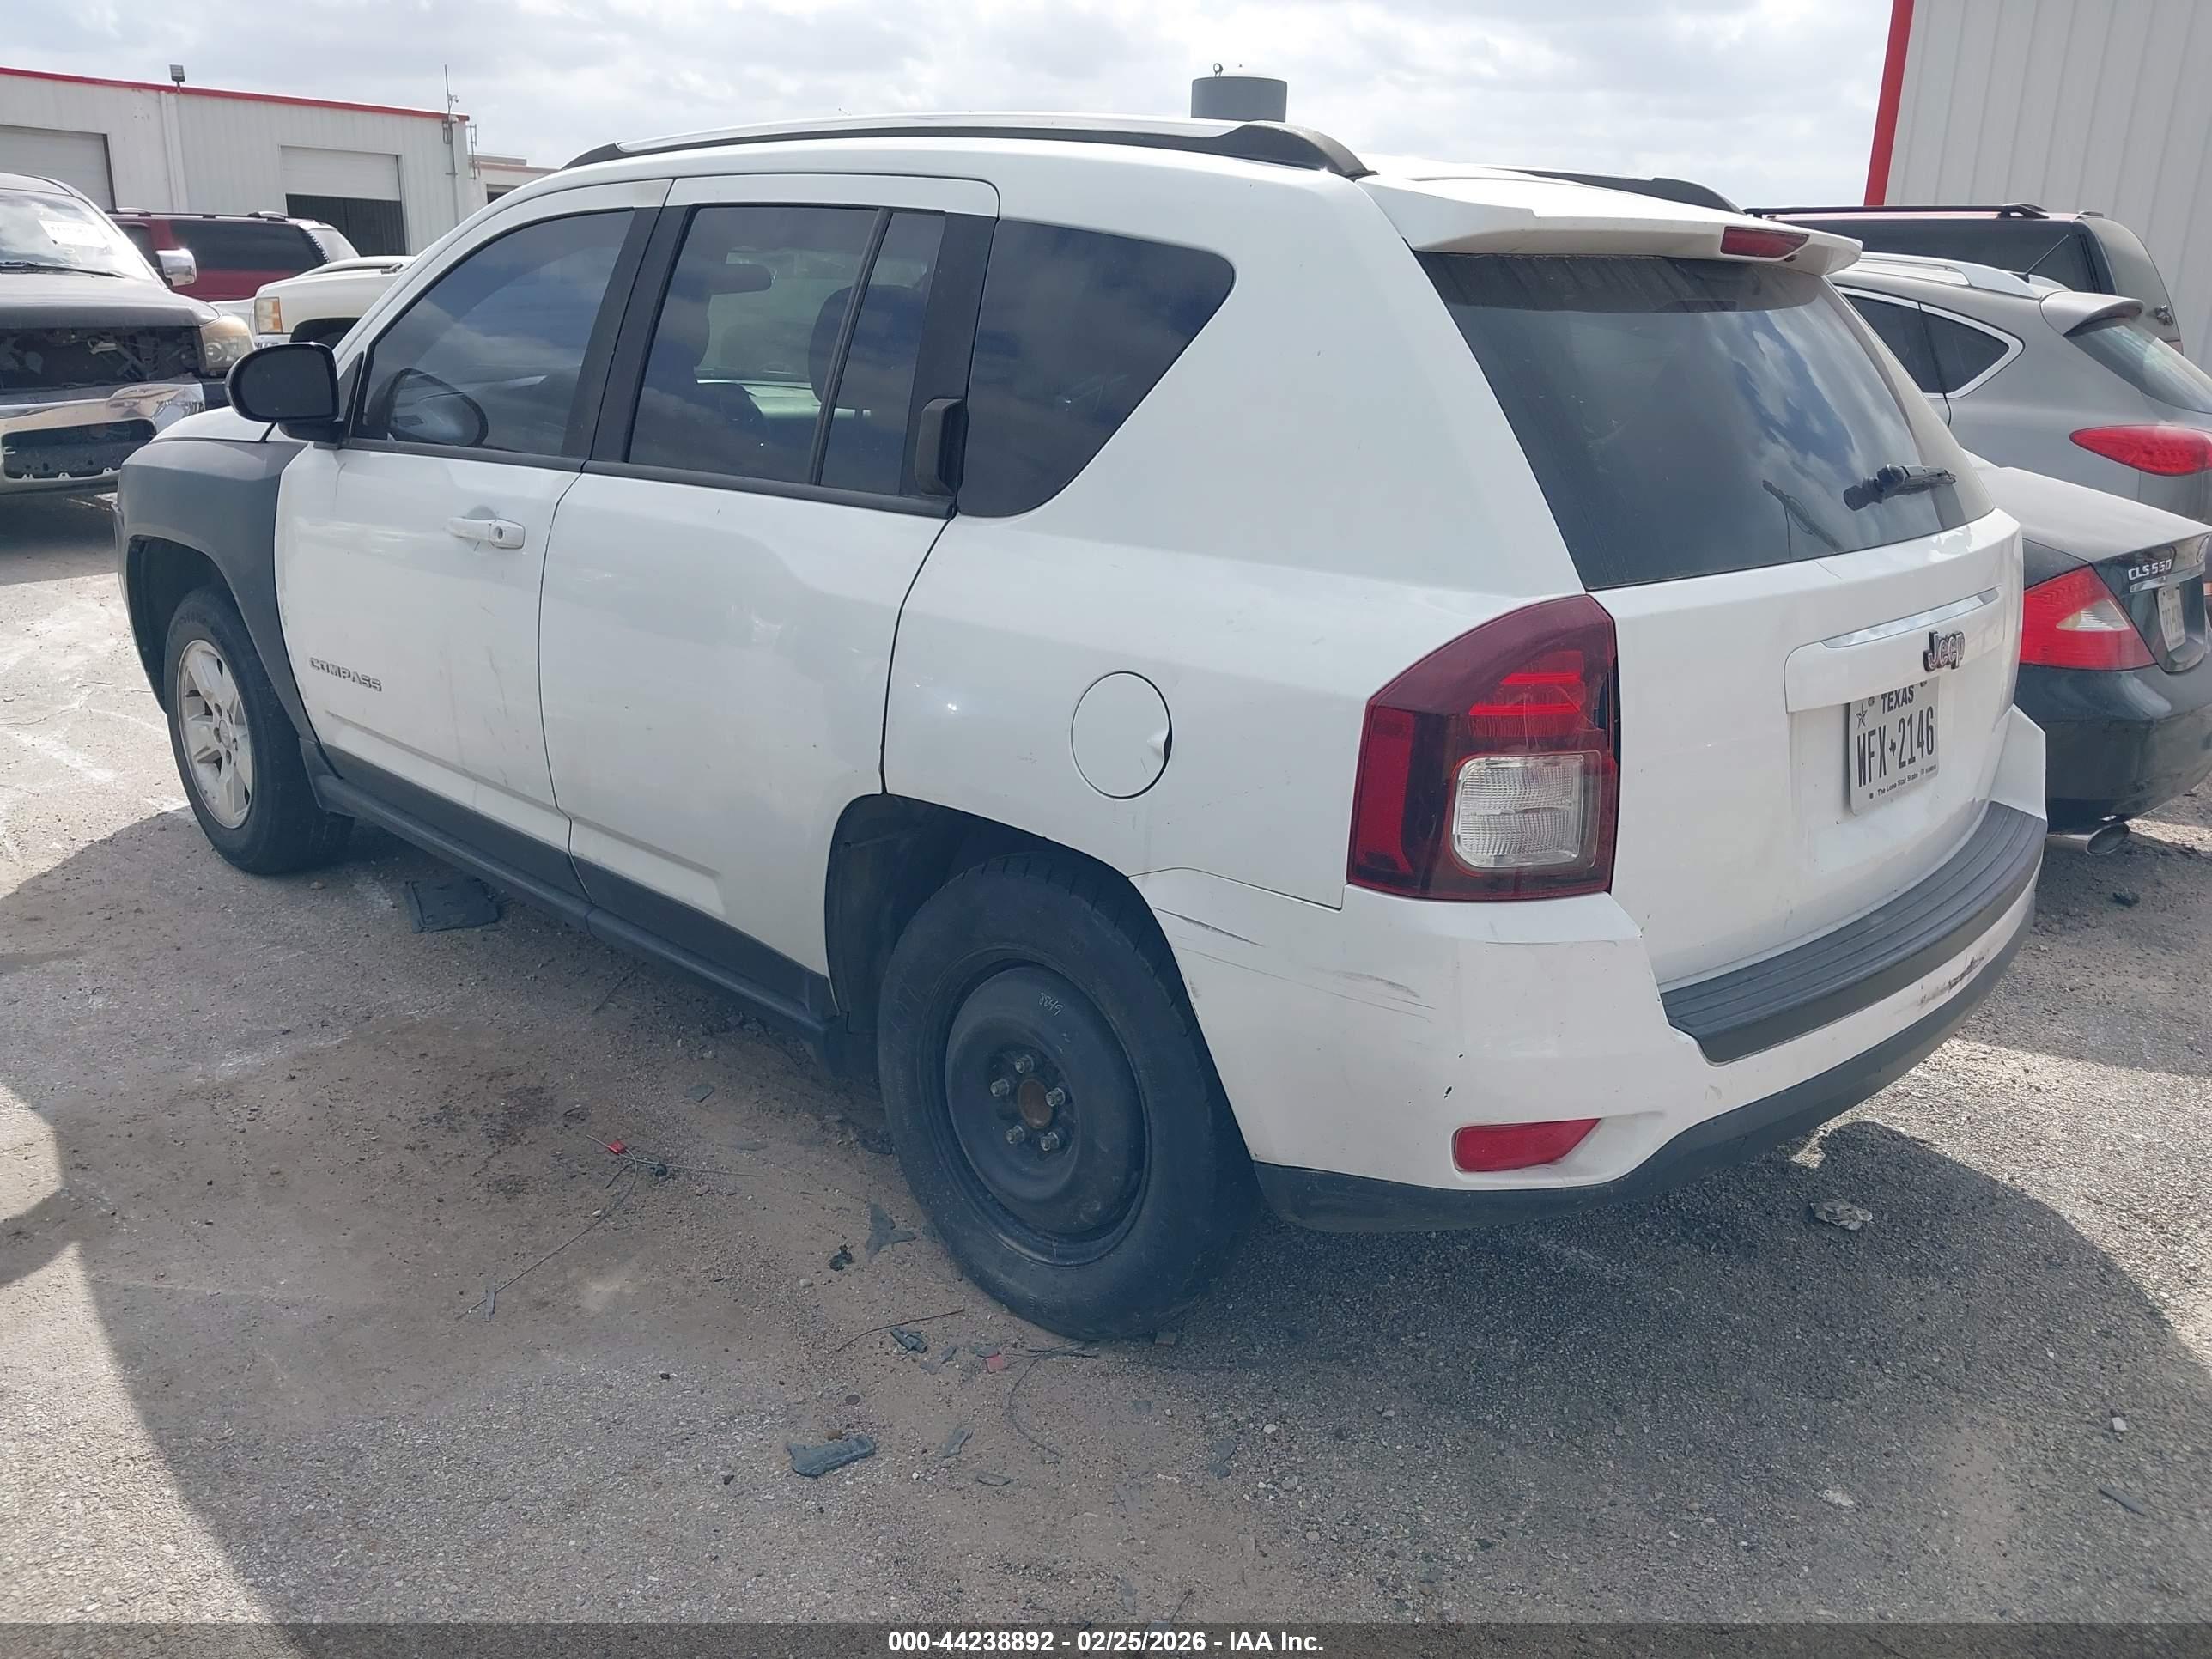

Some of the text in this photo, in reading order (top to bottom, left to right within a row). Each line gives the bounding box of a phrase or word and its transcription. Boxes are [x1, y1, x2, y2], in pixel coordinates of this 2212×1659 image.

[2128, 564, 2149, 580] CLS
[1923, 631, 1965, 672] Jeep
[309, 656, 382, 692] COMPASS
[1881, 685, 1915, 714] TEXAS
[1877, 772, 1918, 797] The Lone Star State
